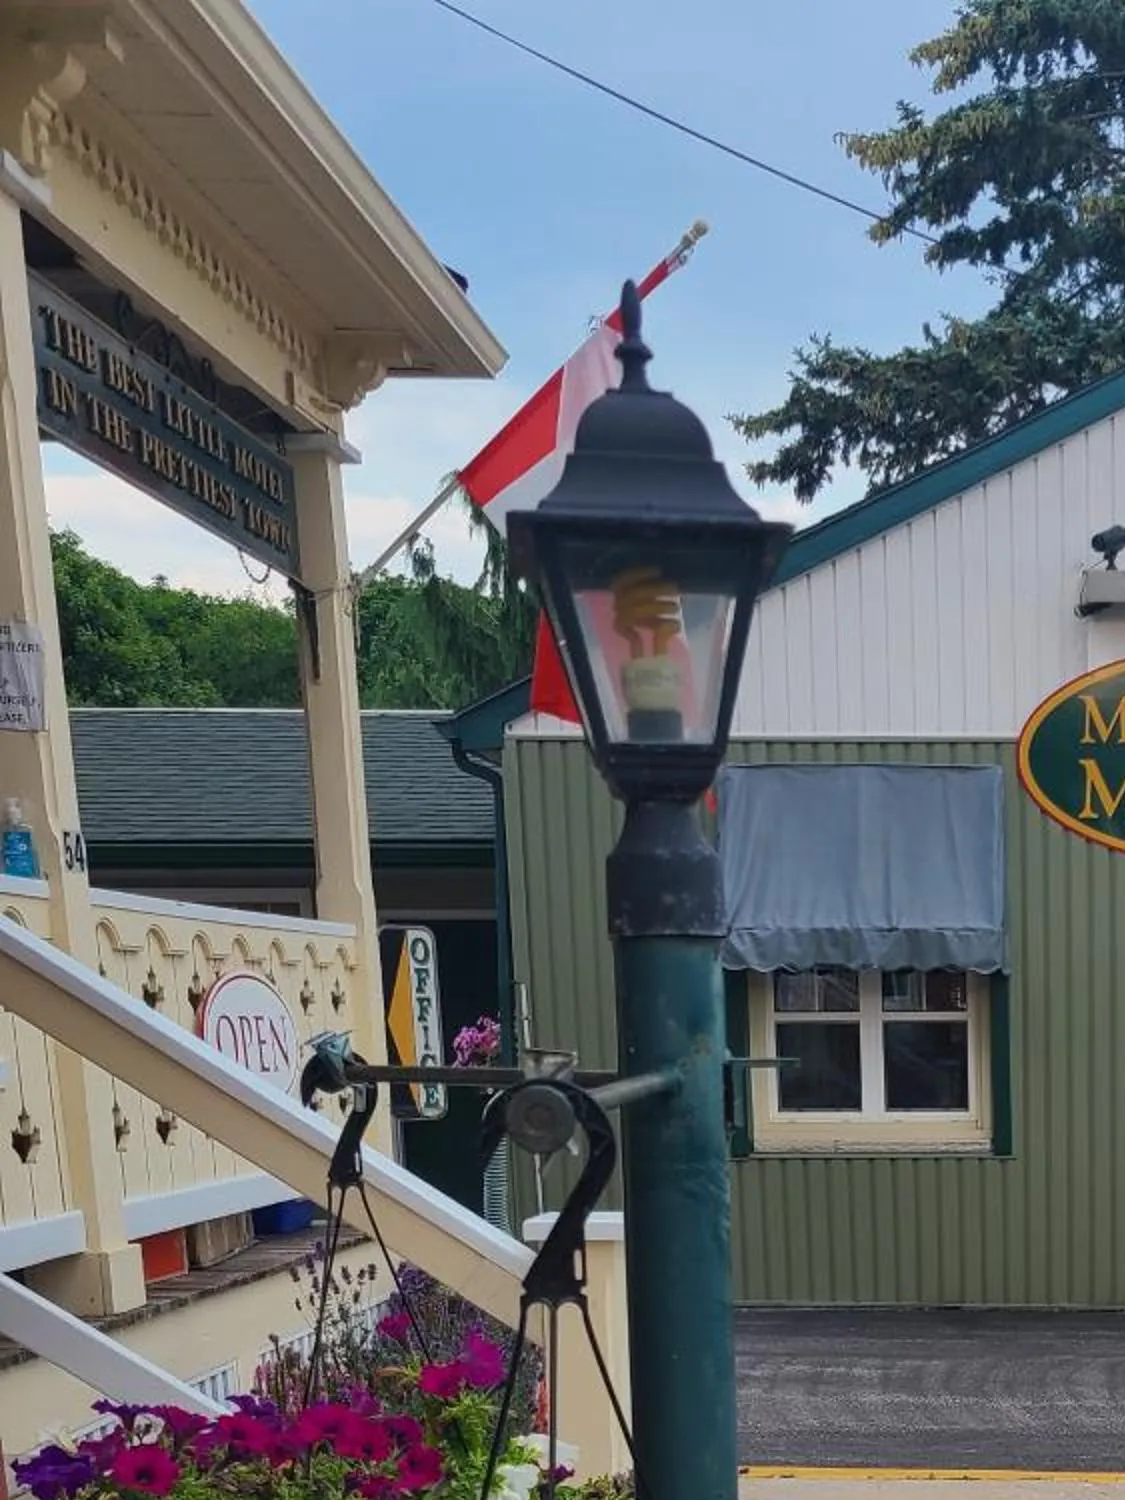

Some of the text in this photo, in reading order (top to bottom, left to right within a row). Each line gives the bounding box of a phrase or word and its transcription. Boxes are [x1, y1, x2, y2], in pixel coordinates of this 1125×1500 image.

[47, 306, 284, 503] THE BEST LITTLE MOTEL
[48, 367, 291, 552] IN THE PRETTIEST TOWN
[63, 830, 85, 873] 54
[216, 1014, 290, 1073] OPEN
